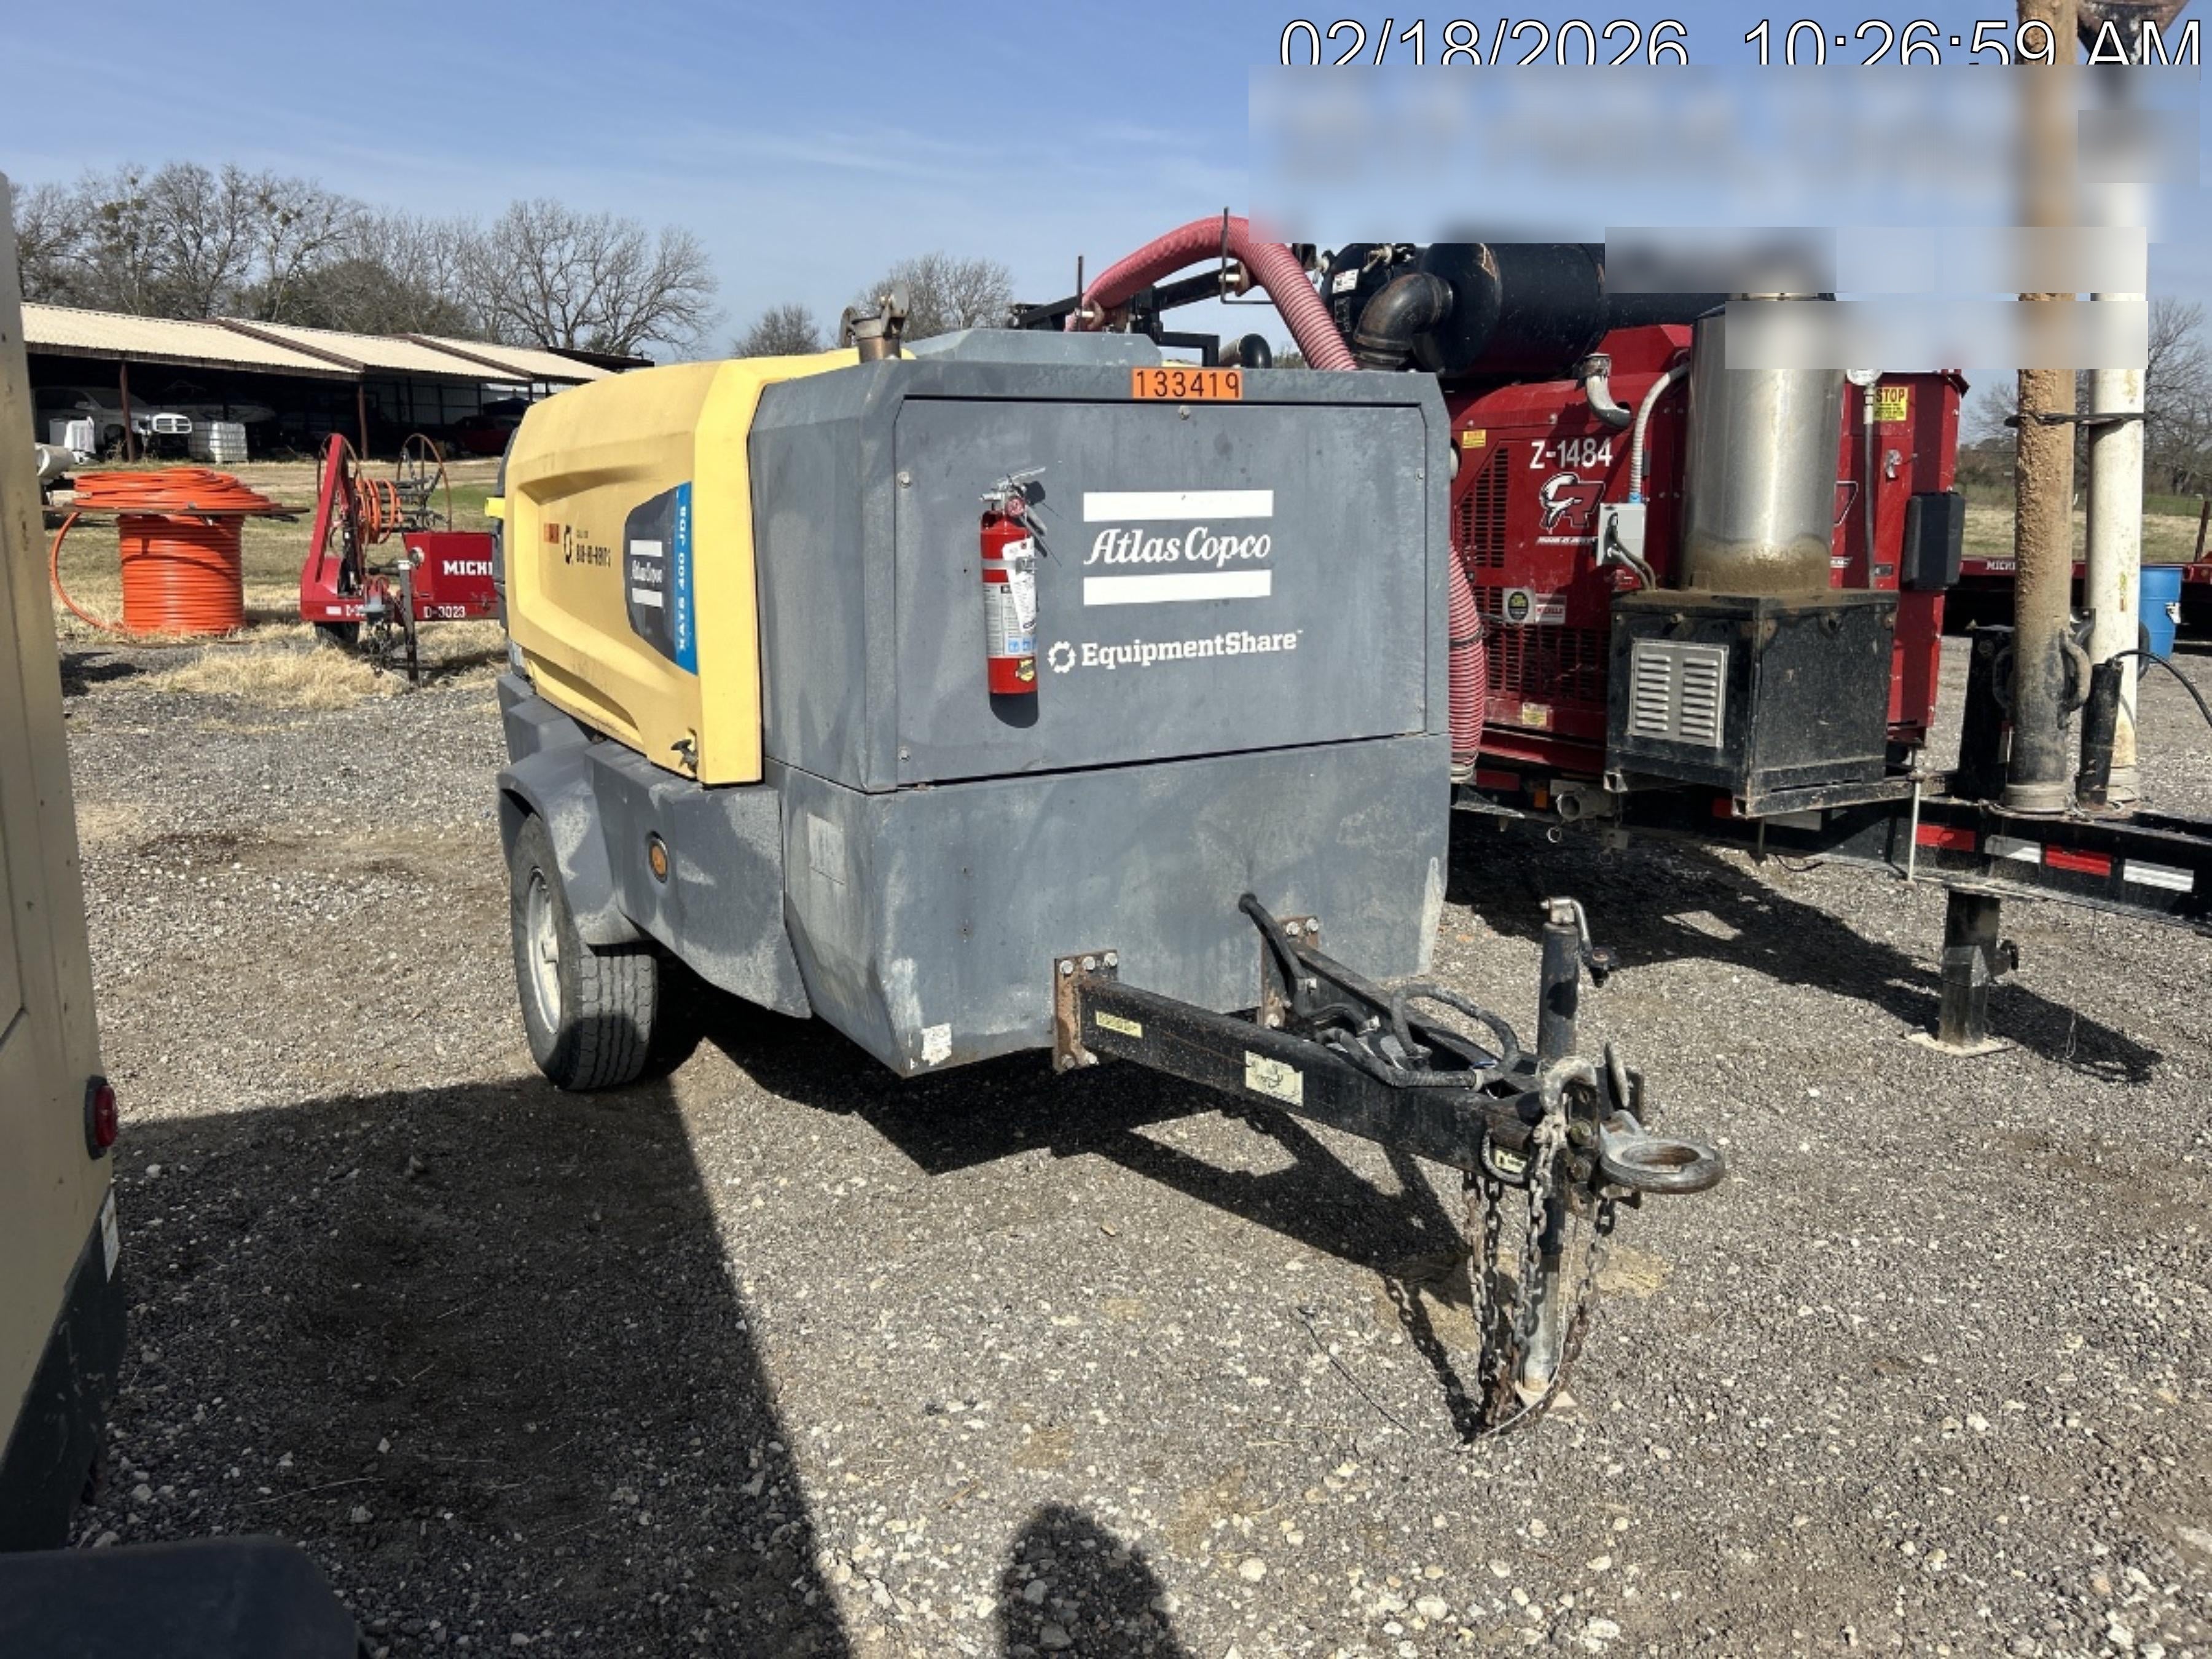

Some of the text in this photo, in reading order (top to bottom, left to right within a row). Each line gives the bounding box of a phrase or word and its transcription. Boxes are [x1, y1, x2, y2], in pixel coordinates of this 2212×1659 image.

[1137, 370, 1239, 399] 133419
[1876, 388, 1904, 402] STOP
[1529, 438, 1614, 469] Z-1484
[1083, 527, 1271, 568] Atlas Copco
[423, 606, 465, 618] D-3023
[1081, 631, 1296, 669] EquipmentShare
